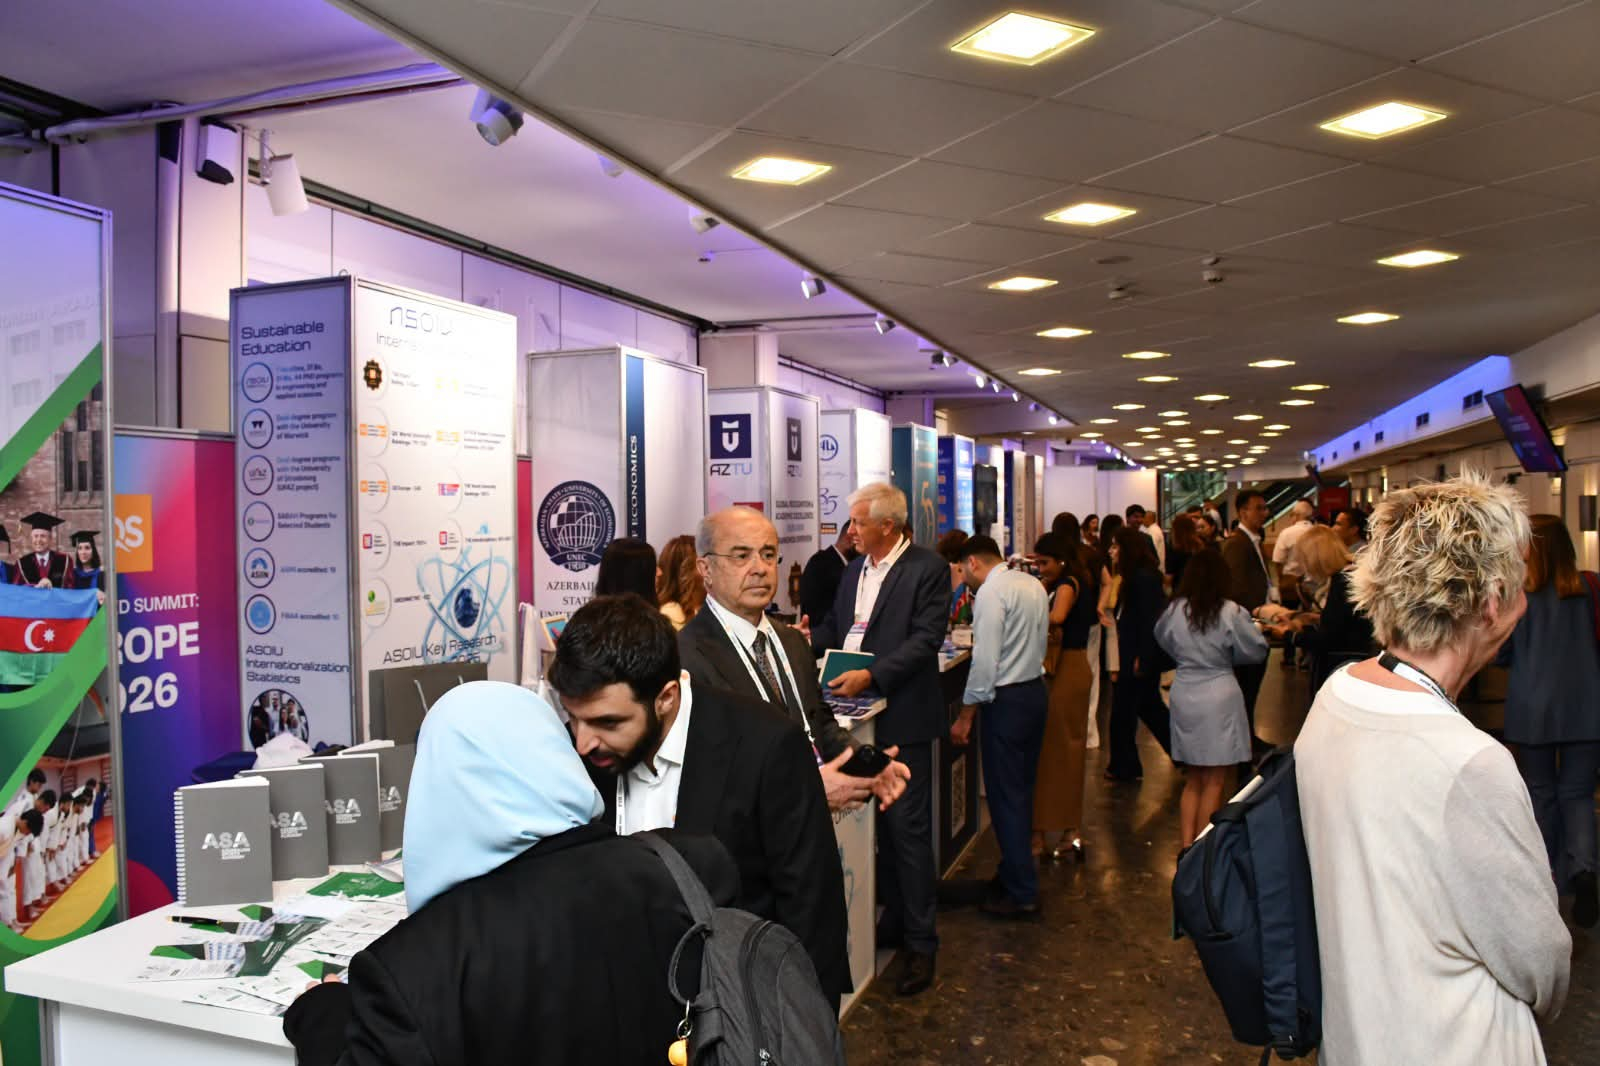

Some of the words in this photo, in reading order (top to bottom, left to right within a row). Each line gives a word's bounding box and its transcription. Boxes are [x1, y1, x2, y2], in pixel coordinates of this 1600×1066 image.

[241, 321, 324, 340] Sustainable
[241, 340, 311, 356] Education
[710, 463, 753, 476] AZTU
[630, 435, 638, 526] ECONOMICS
[566, 553, 587, 561] UNEC
[547, 581, 594, 592] AZERBAIJ
[119, 599, 130, 615] D
[133, 593, 199, 613] SUMMIT:
[117, 621, 200, 664] OPE
[426, 643, 446, 656] Key
[246, 645, 283, 656] ASOIU
[246, 659, 350, 673] Internationalization
[246, 672, 301, 684] Statistics
[118, 672, 178, 713] 26
[380, 786, 401, 801] SA
[201, 831, 250, 850] ASA
